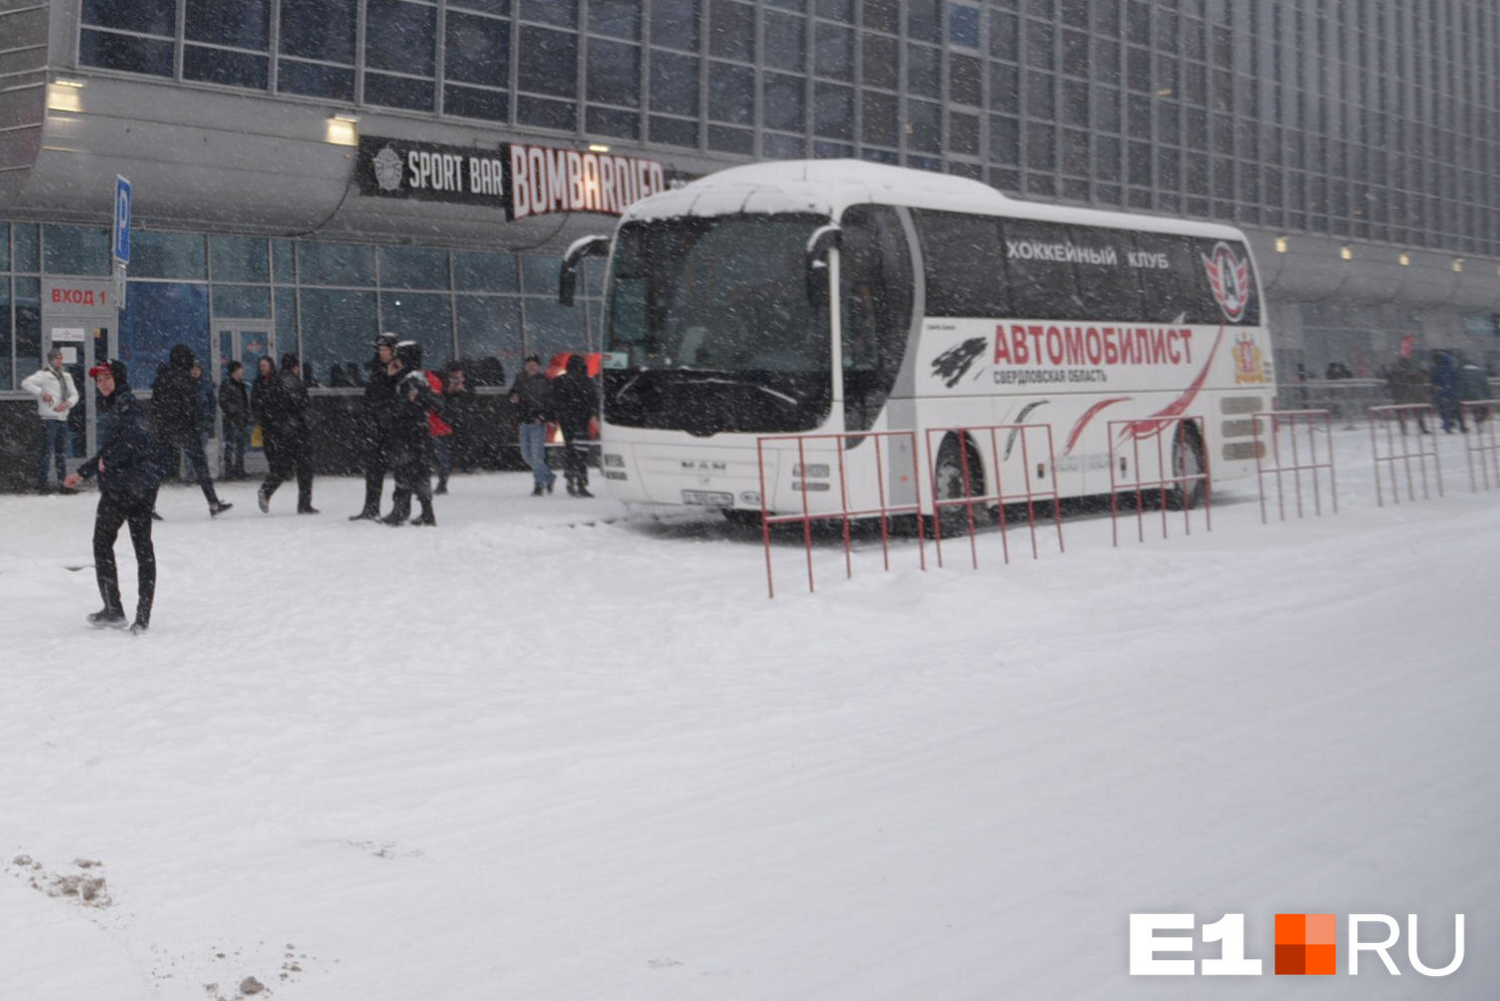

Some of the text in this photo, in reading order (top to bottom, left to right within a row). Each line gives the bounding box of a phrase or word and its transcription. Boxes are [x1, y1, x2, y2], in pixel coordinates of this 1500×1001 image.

[408, 150, 463, 191] SPORT
[470, 156, 504, 196] BAR
[1006, 239, 1170, 270] ХОККЕЙНЫЙ КЛУБ
[51, 288, 95, 307] ВХОД
[993, 324, 1193, 366] АВТОМОБИЛИСТ
[993, 369, 1108, 386] СВЕРДЛОВСКАЯ ОБЛАСТЬ
